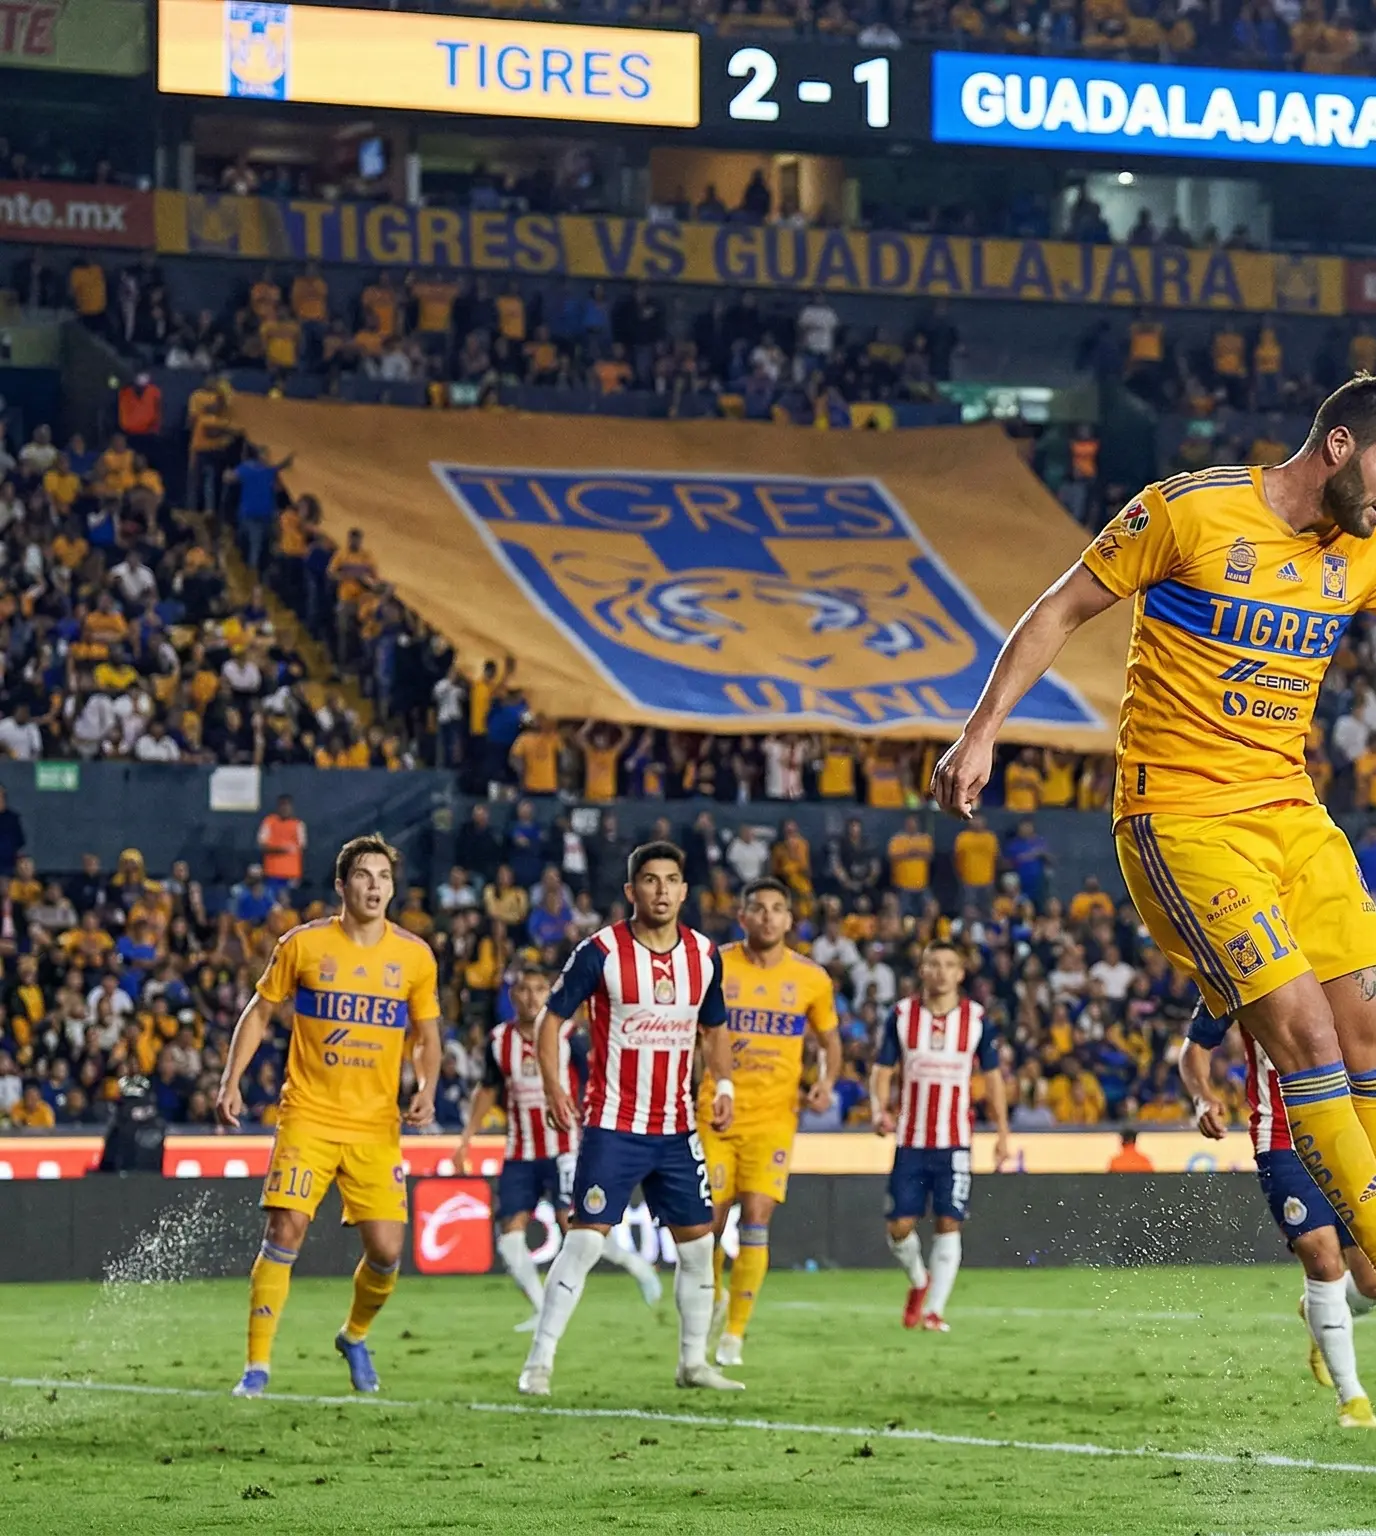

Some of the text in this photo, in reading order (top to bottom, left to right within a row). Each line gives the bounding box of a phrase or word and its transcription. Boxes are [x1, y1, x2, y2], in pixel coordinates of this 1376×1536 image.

[436, 41, 652, 98] TIGRES
[728, 48, 890, 127] 2 - 1
[289, 202, 1244, 303] TIGRES VS GUADALAJARA
[459, 476, 895, 537] TIGRES
[1209, 598, 1340, 654] TIGRES
[723, 683, 976, 722] UANL
[315, 991, 398, 1026] TIGRES
[728, 1008, 796, 1034] IGRES
[284, 1166, 313, 1199] 10
